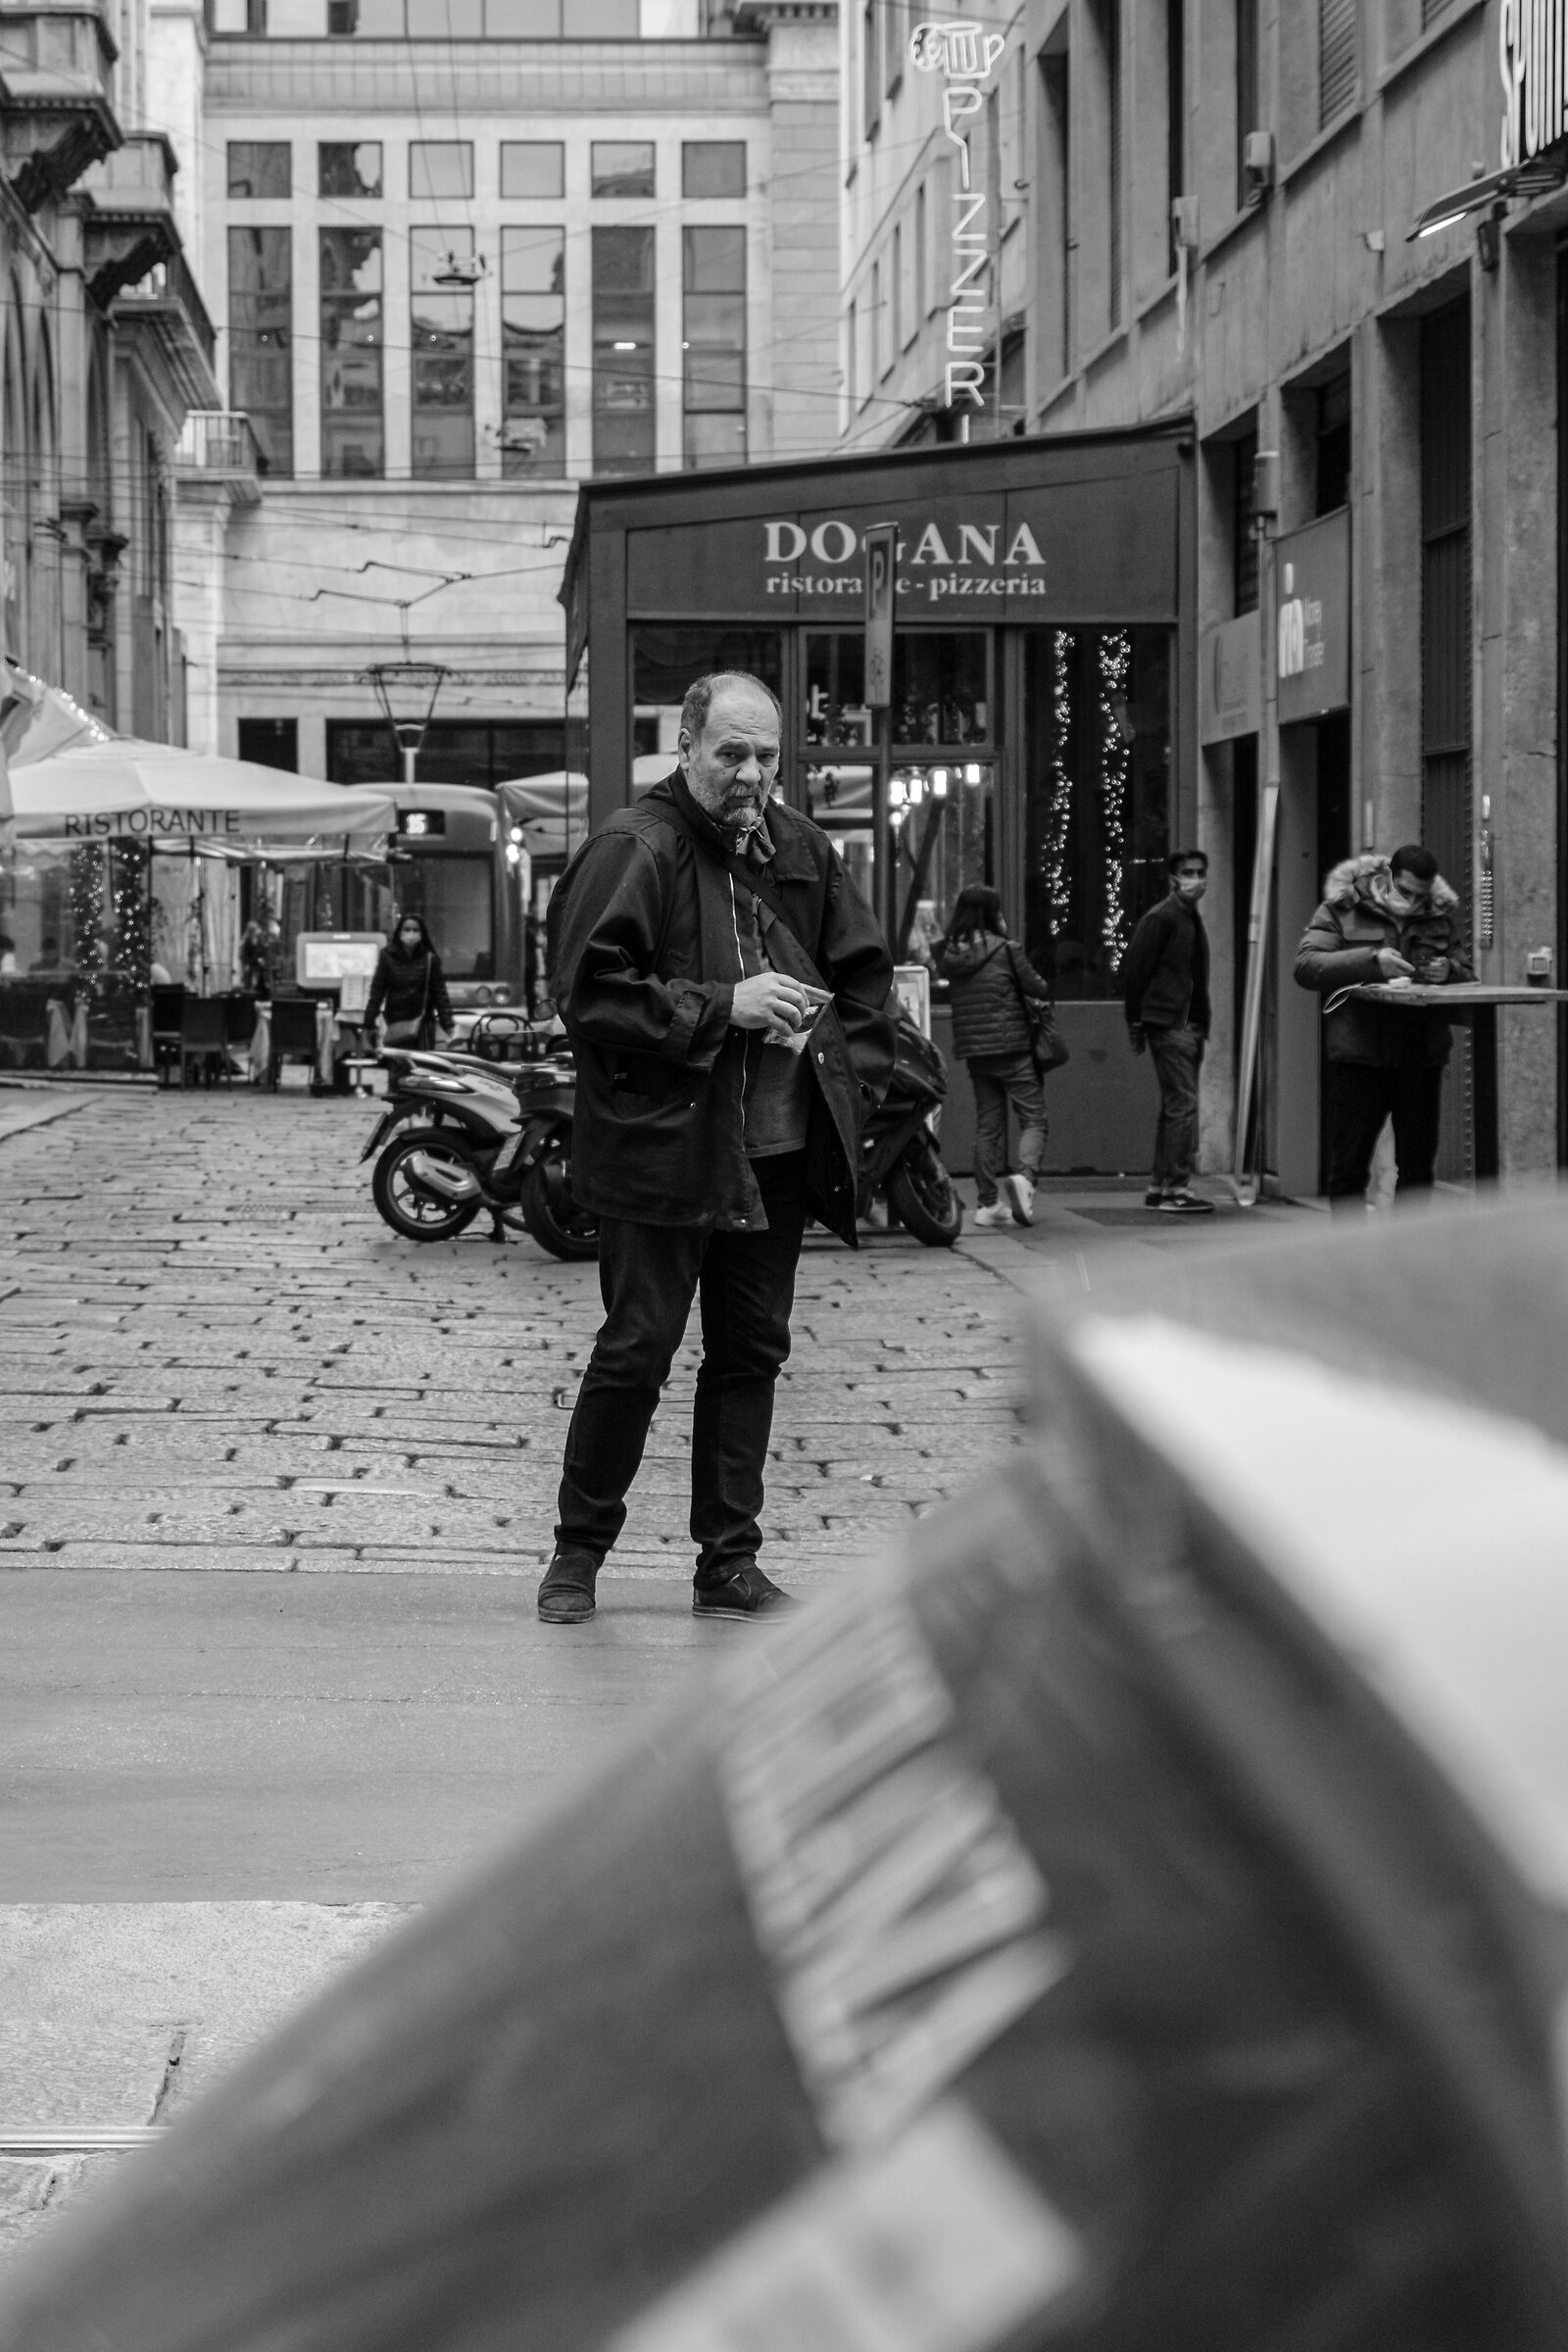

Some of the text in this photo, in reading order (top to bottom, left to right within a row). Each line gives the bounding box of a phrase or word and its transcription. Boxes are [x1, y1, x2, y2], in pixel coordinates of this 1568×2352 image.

[764, 520, 1047, 564] DOANA
[766, 572, 911, 594] ristorae
[928, 572, 1047, 601] pizzeria
[65, 809, 240, 836] RISTORANTE
